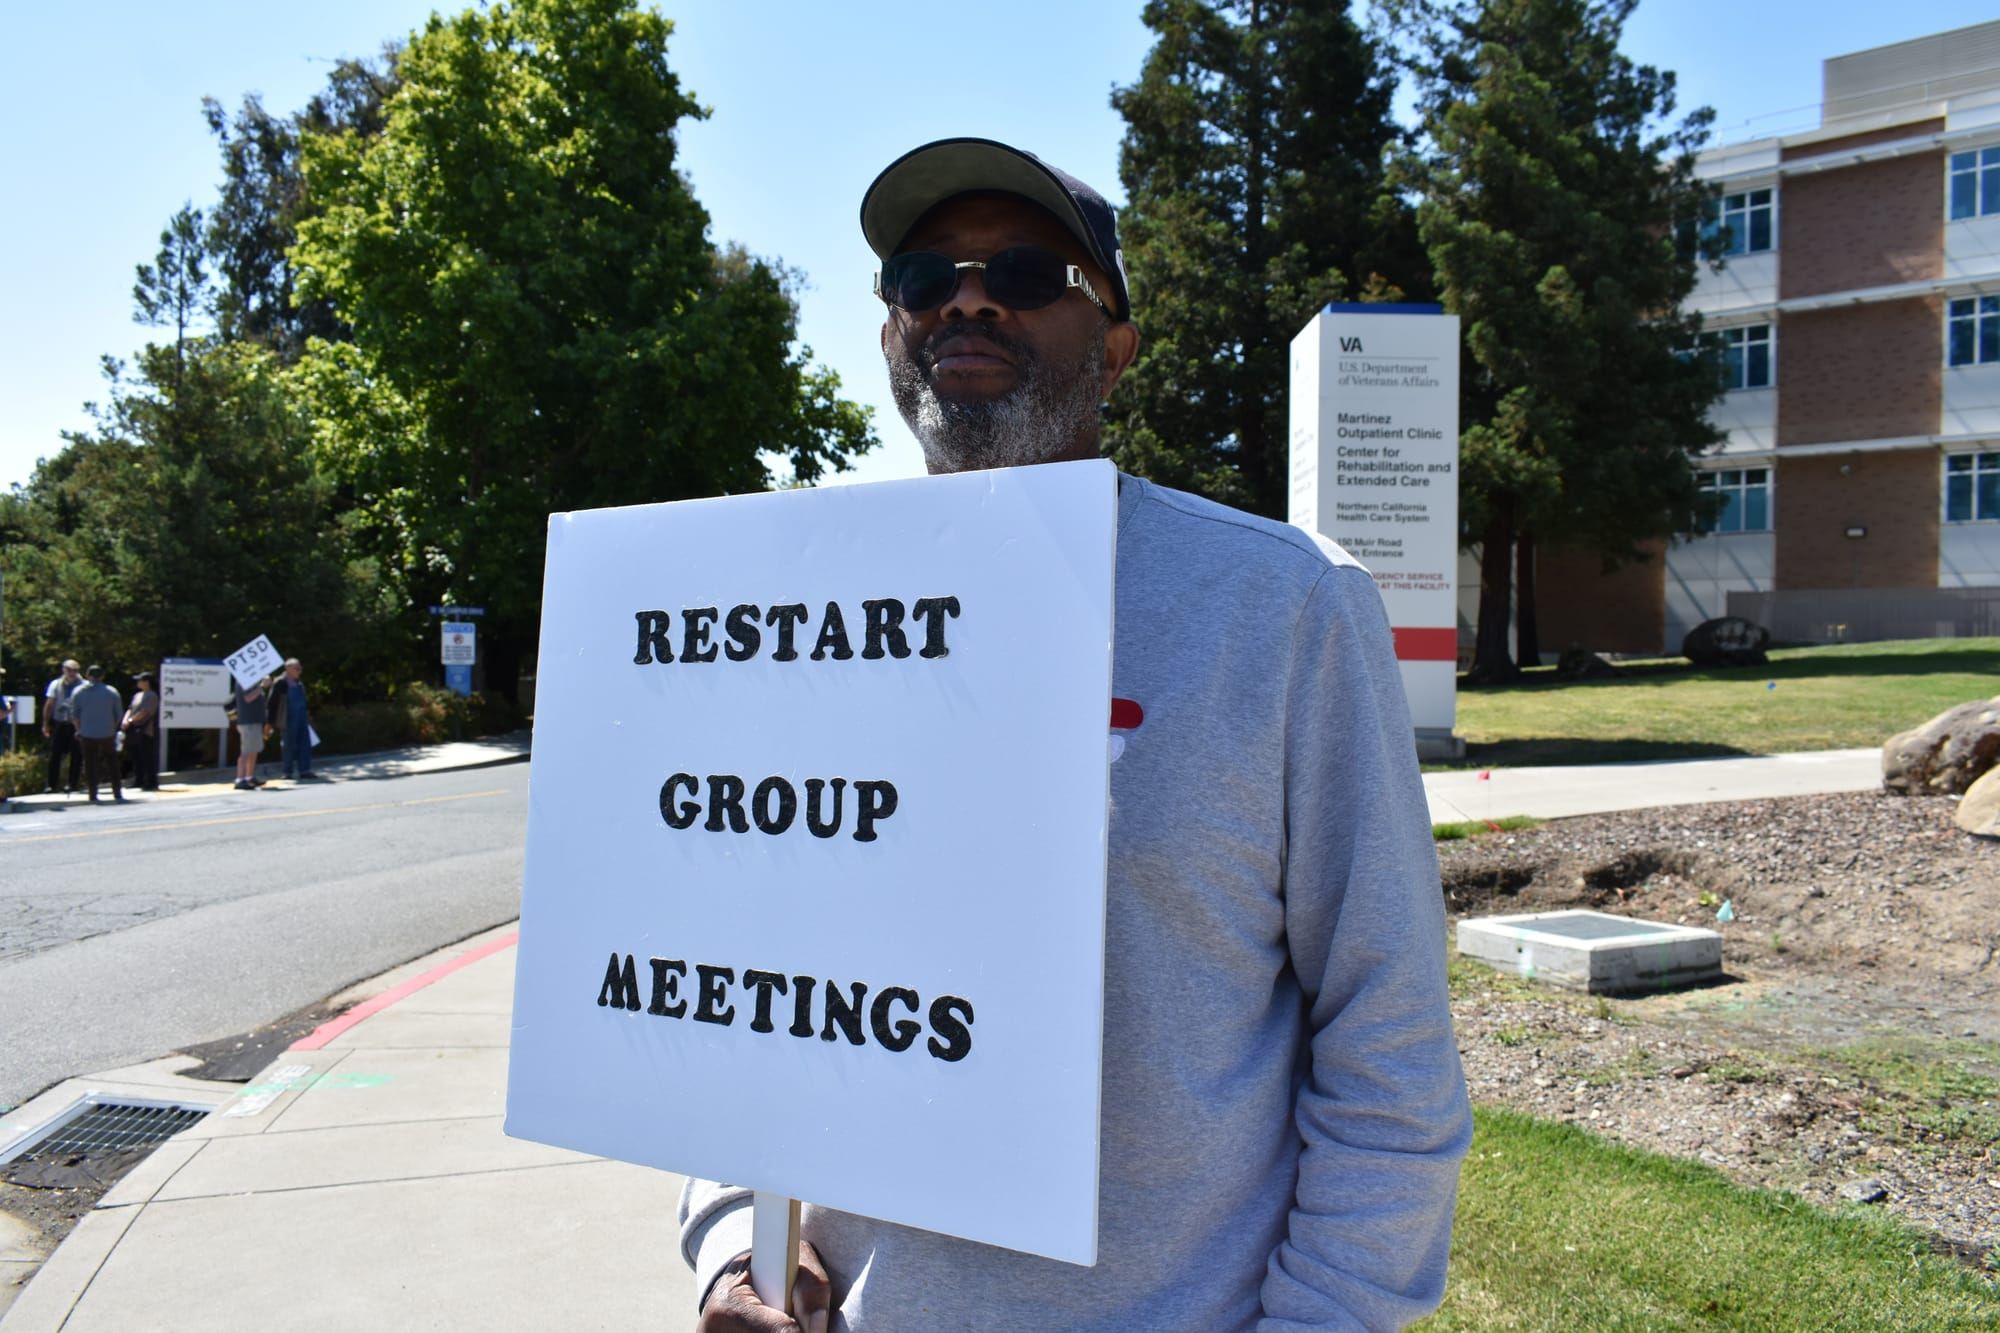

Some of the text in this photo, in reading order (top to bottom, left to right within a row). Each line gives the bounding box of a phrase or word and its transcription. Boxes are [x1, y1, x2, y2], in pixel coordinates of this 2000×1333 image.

[1339, 336, 1363, 352] VA
[1361, 362, 1428, 375] Department
[1350, 375, 1399, 386] Veterans
[1401, 376, 1439, 387] Affairs
[1337, 412, 1392, 424] Martinez
[1337, 427, 1443, 440] Outpatient Clinic
[1337, 446, 1400, 458] Center for
[1337, 460, 1451, 472] Rehabilitation and
[1337, 474, 1430, 487] Extended Care
[1336, 502, 1427, 512] Northern California
[1336, 513, 1430, 524] Health Care System
[1354, 537, 1376, 546] Muir
[1378, 537, 1402, 547] Road
[1362, 548, 1404, 557] Entrance
[634, 596, 961, 665] RESTART
[228, 640, 268, 671] PTSD
[659, 773, 899, 842] GROUP
[597, 952, 974, 1062] MEETINGS
